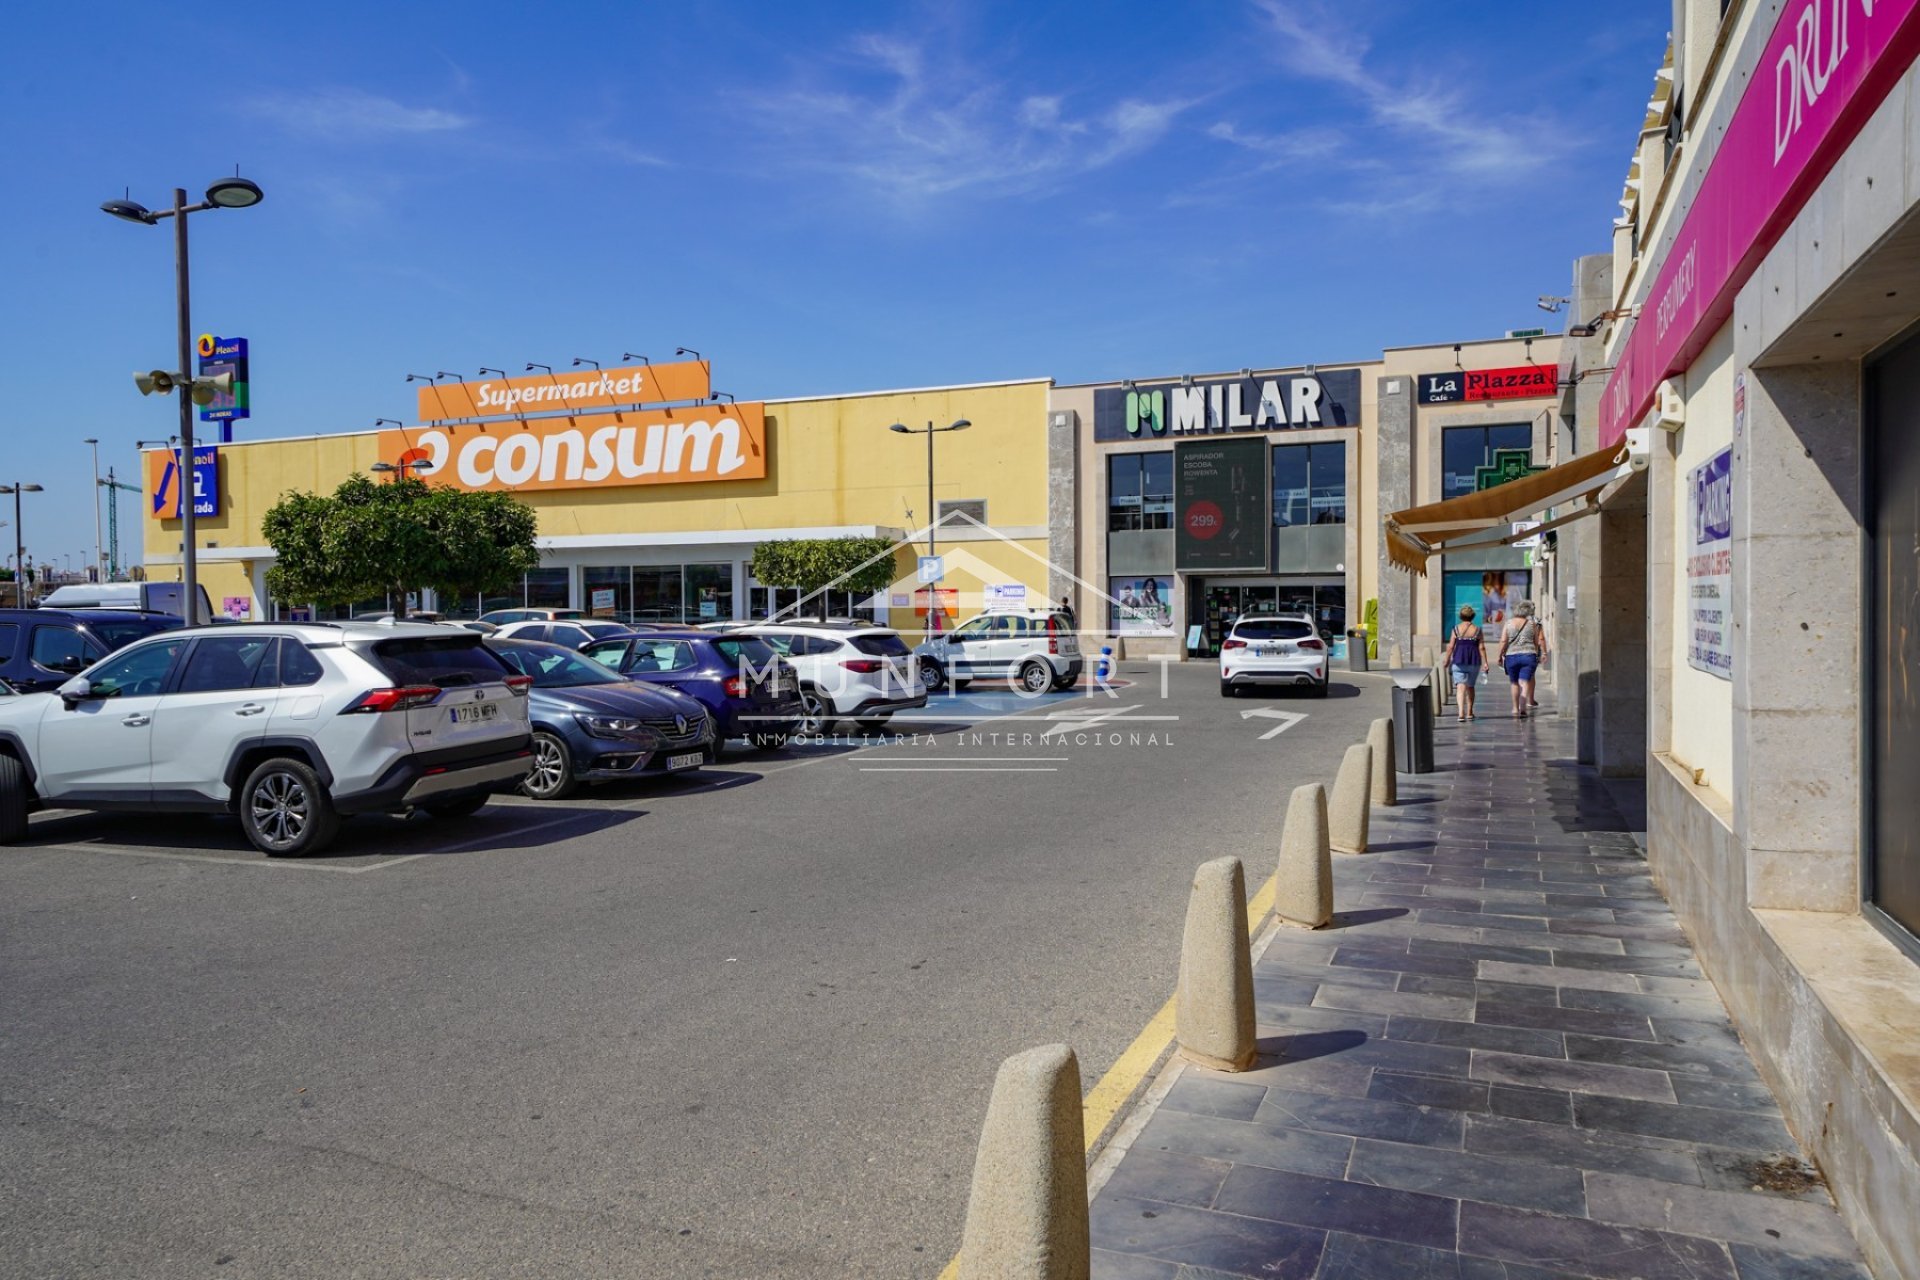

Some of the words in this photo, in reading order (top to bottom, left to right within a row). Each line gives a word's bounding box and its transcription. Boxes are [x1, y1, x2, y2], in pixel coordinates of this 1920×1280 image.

[1655, 238, 1697, 345] PERFUMERY
[477, 372, 643, 412] Supermarket
[1428, 377, 1457, 393] La
[1467, 370, 1546, 390] Plazza
[1171, 377, 1321, 431] MILAR
[456, 417, 746, 488] consum
[1183, 452, 1224, 461] ASPIRADOR
[922, 559, 939, 580] P
[457, 706, 480, 720] 1716
